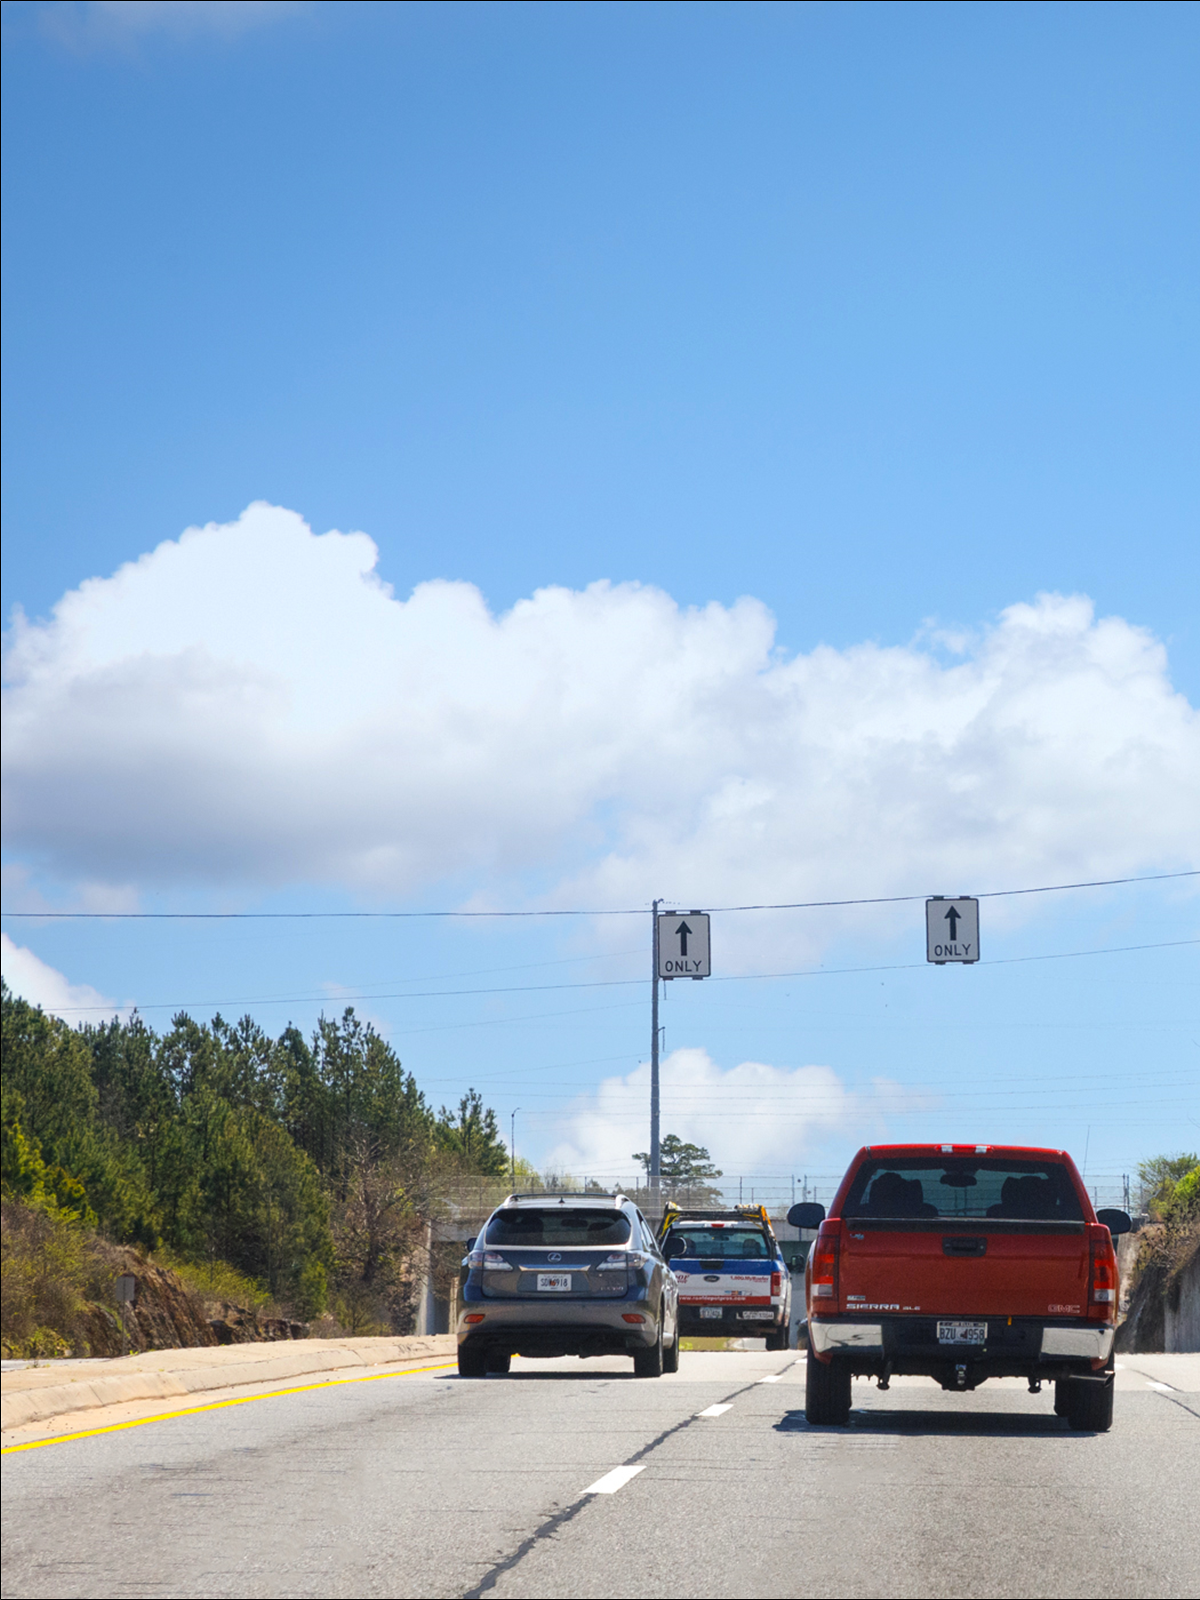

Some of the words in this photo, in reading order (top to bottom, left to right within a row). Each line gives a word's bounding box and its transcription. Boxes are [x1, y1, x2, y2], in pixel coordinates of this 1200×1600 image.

[934, 943, 971, 957] ONLY
[665, 960, 702, 972] ONLY
[1048, 1304, 1080, 1313] GMC
[940, 1327, 957, 1340] BZU
